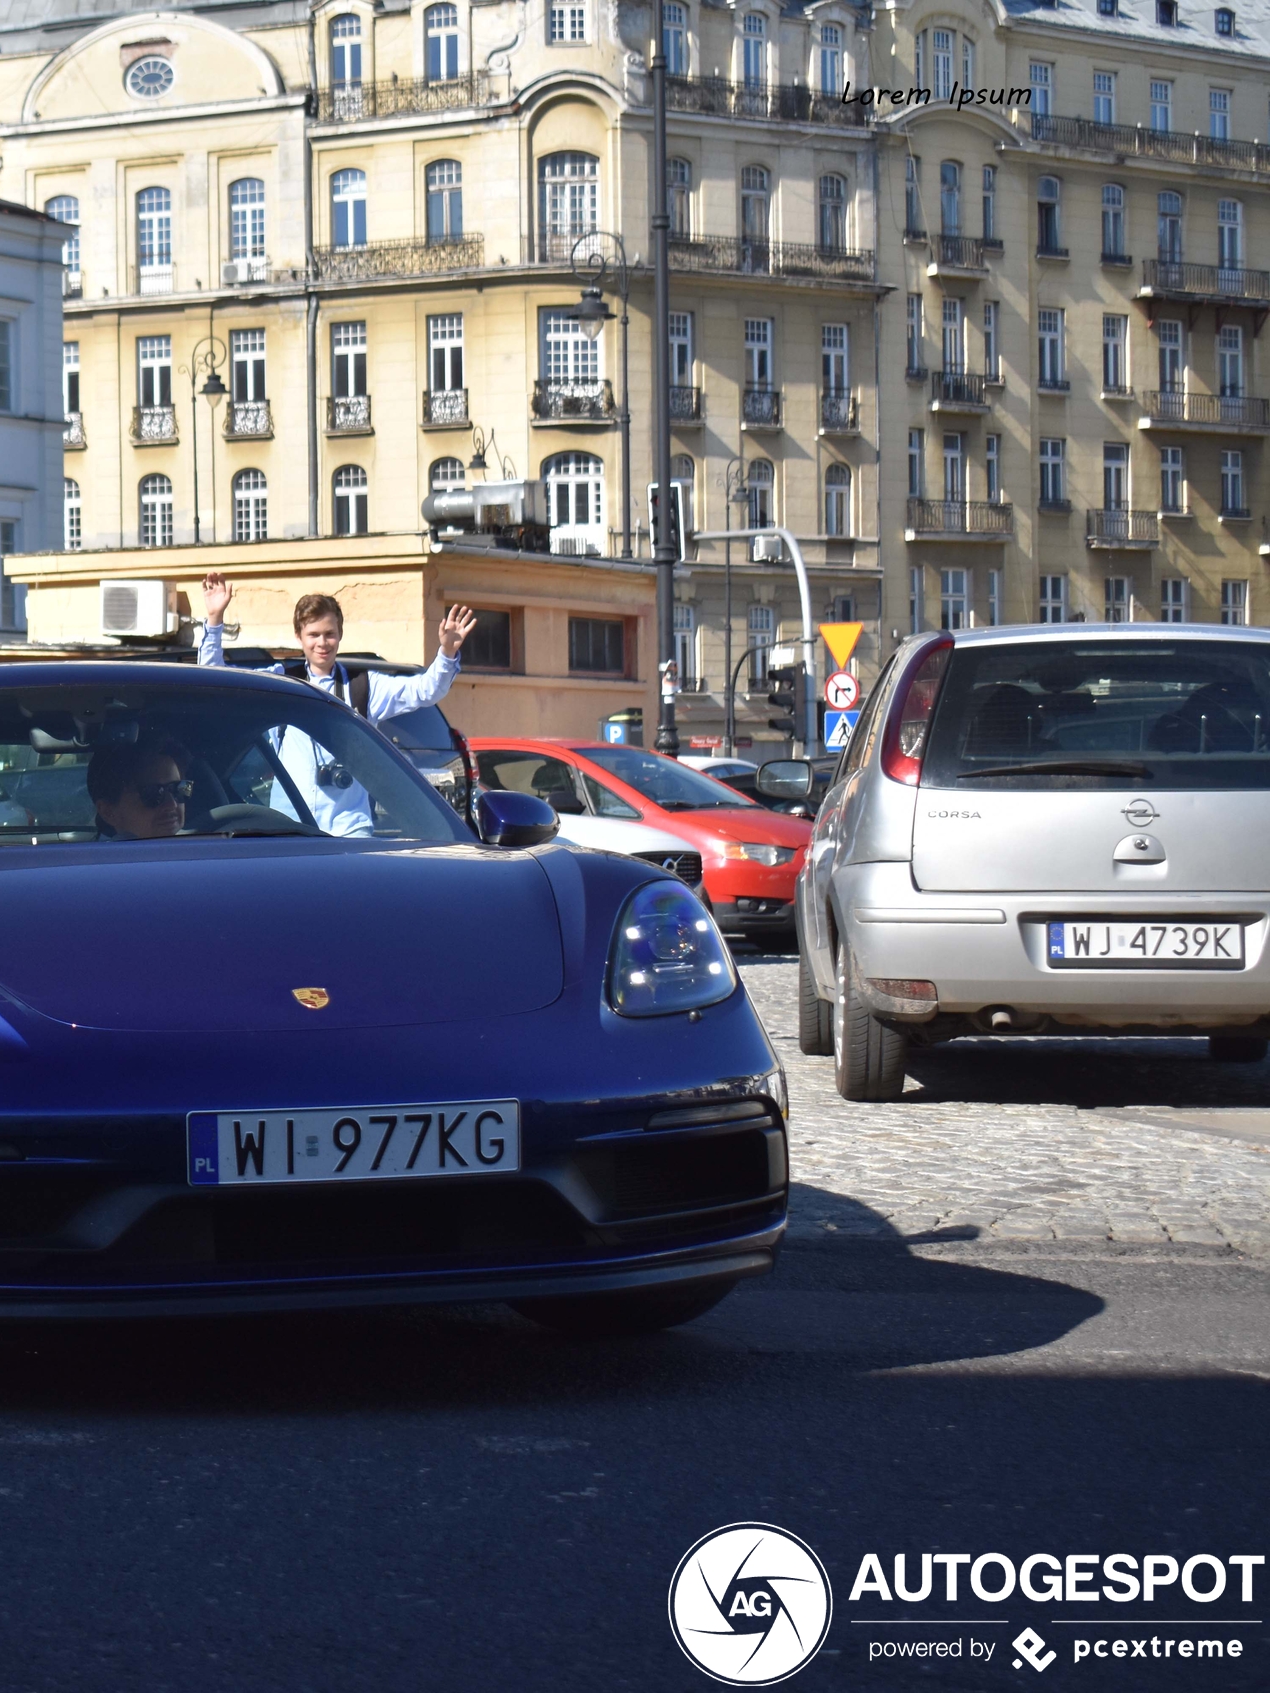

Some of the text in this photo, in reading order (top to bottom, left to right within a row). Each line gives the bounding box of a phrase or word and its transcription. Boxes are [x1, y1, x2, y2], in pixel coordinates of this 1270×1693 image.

[609, 725, 622, 744] P
[928, 810, 982, 819] CORSA
[1072, 926, 1232, 957] WJ 4739K
[1051, 946, 1064, 955] PL
[232, 1110, 506, 1176] WI 977KG
[195, 1158, 216, 1173] PL
